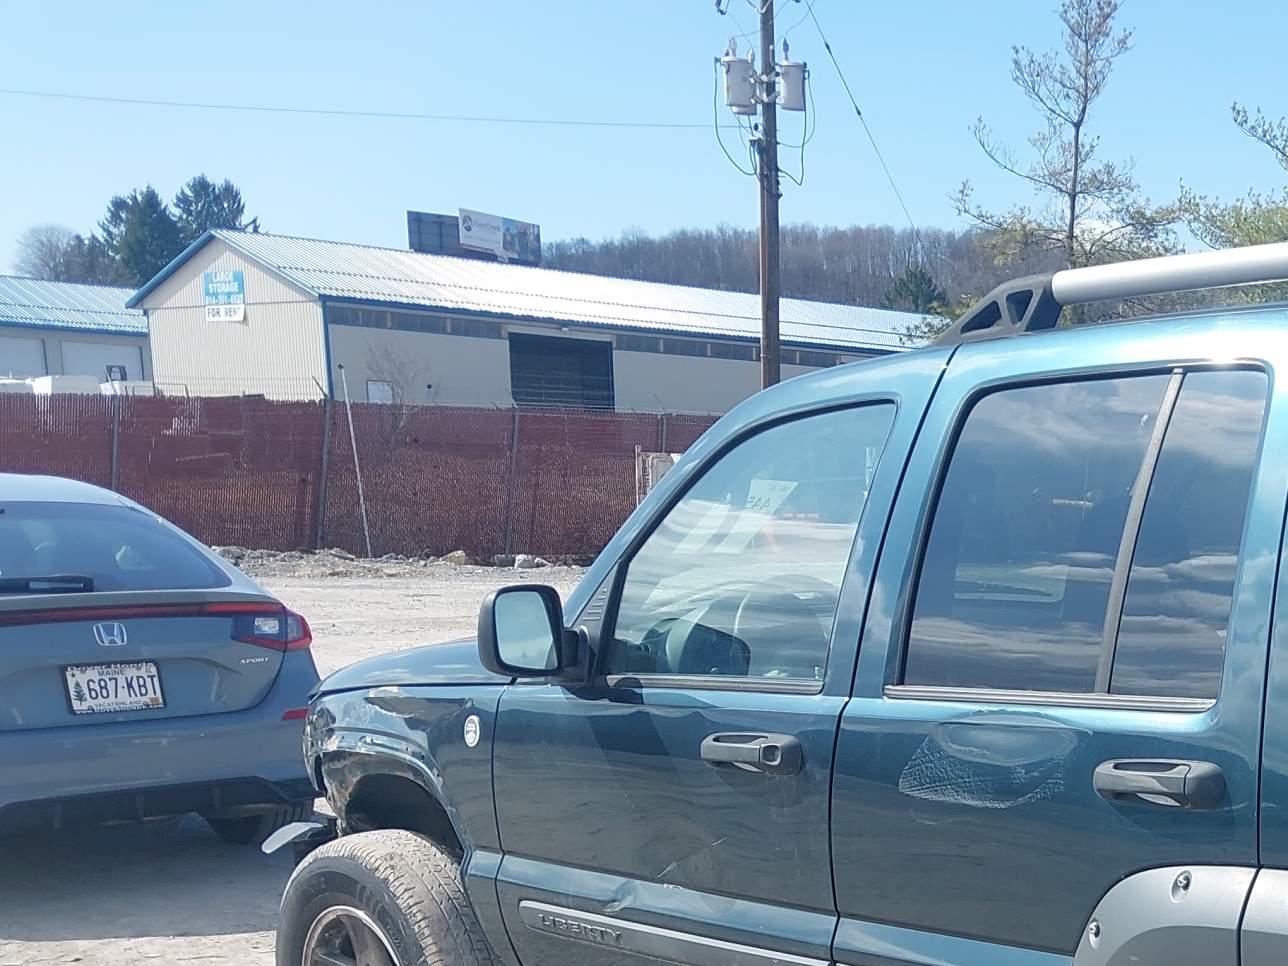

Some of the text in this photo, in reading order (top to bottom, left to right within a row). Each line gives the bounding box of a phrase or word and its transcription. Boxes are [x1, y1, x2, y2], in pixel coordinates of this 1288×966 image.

[208, 282, 239, 293] STORAGE
[207, 306, 241, 318] FOR RENT
[97, 668, 126, 676] MAINE
[538, 913, 622, 943] LIBERTY
